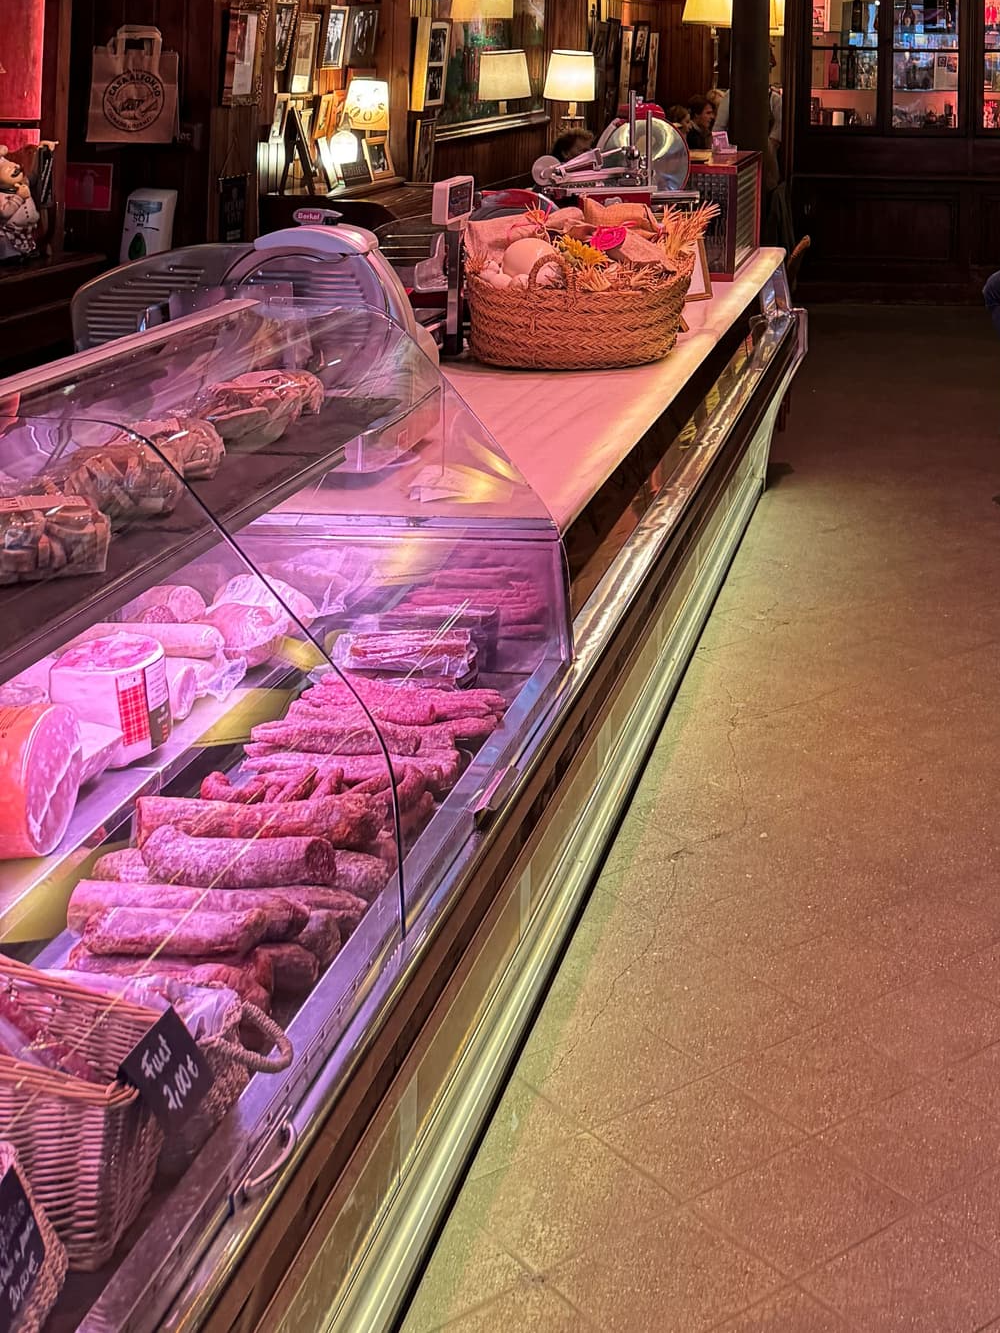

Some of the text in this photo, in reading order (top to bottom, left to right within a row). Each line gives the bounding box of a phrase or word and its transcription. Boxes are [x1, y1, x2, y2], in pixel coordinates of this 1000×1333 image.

[109, 73, 161, 97] CASA ALFONSO
[141, 1033, 172, 1080] Fuet
